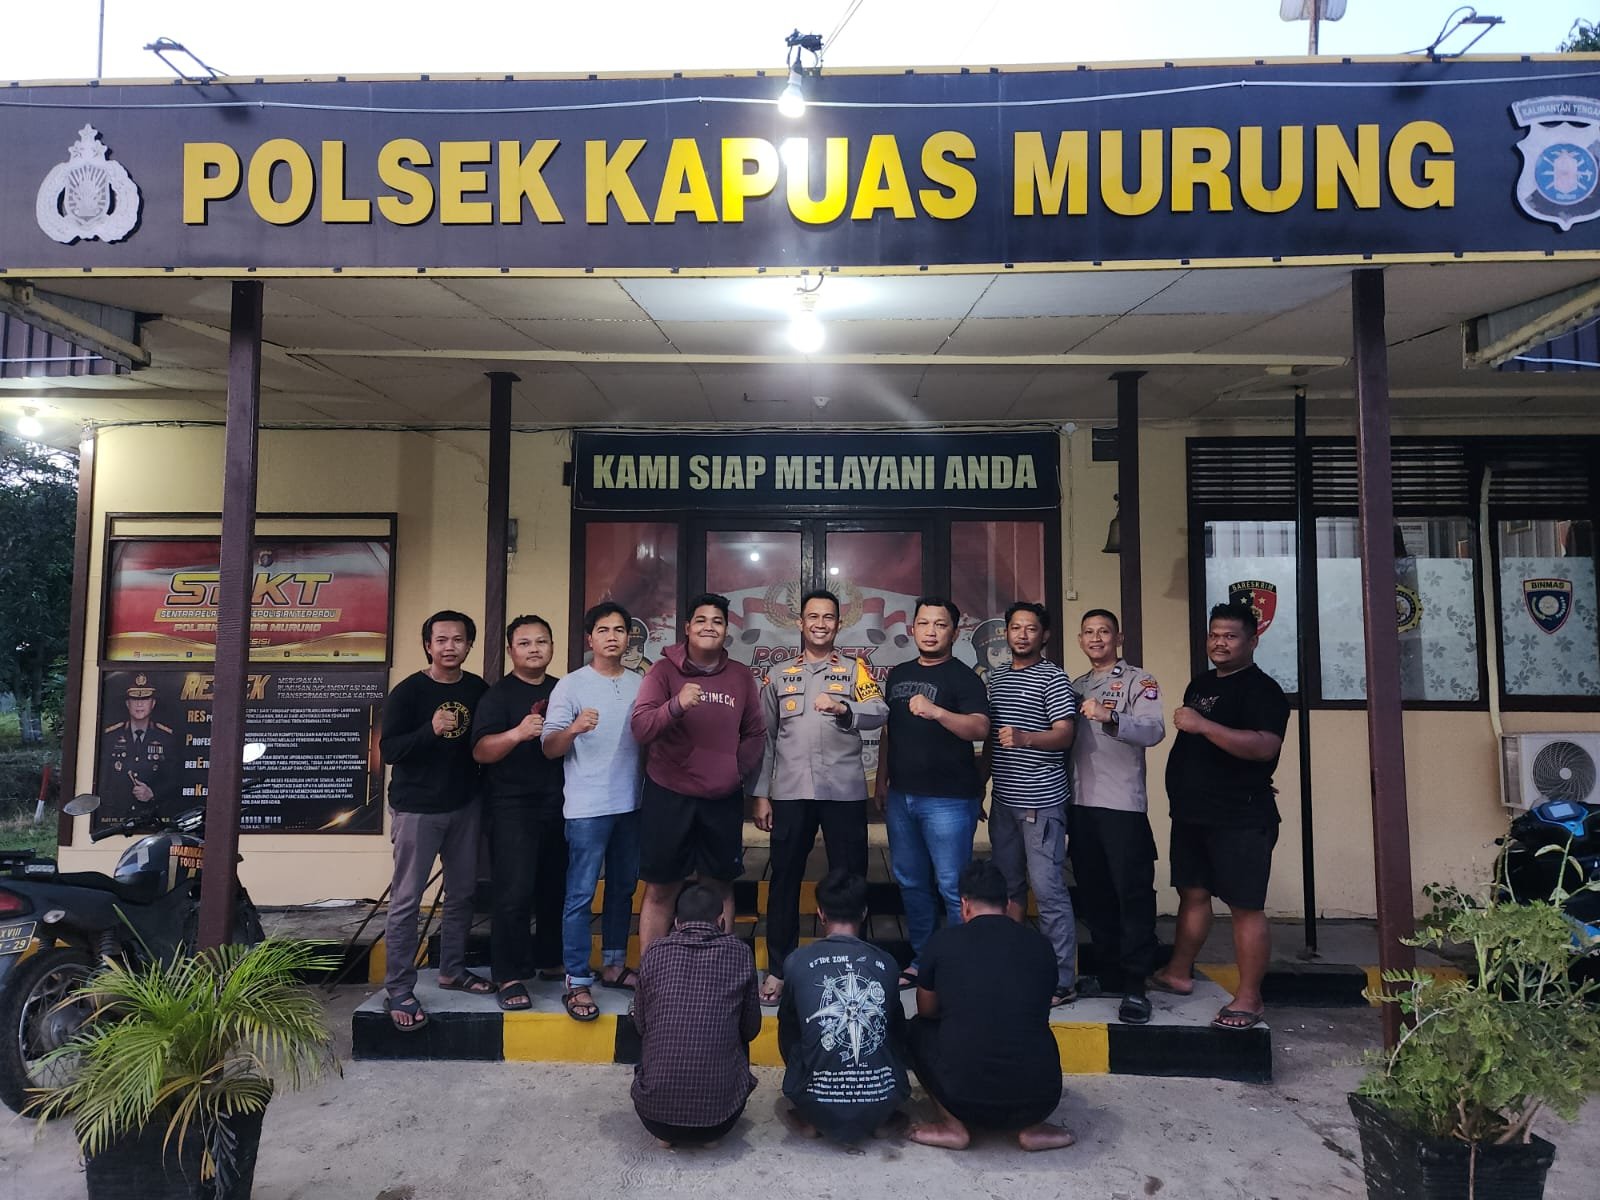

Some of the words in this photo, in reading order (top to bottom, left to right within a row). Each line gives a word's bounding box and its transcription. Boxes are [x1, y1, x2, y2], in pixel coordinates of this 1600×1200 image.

[1573, 103, 1600, 116] TENGA
[182, 138, 565, 226] POLSEK
[585, 130, 978, 224] KAPUAS
[1013, 120, 1456, 217] MURUNG
[592, 454, 680, 490] KAMI
[688, 454, 767, 490] SIAP
[774, 454, 935, 490] MELAYANI
[943, 453, 1038, 490] ANDA
[166, 572, 333, 606] SKT
[1232, 581, 1274, 591] BARESKRIM
[1531, 581, 1565, 589] BINMAS
[252, 609, 295, 619] EPOLISIAN
[824, 675, 851, 683] POLRI
[180, 856, 195, 869] FOOD
[13, 940, 26, 950] 29
